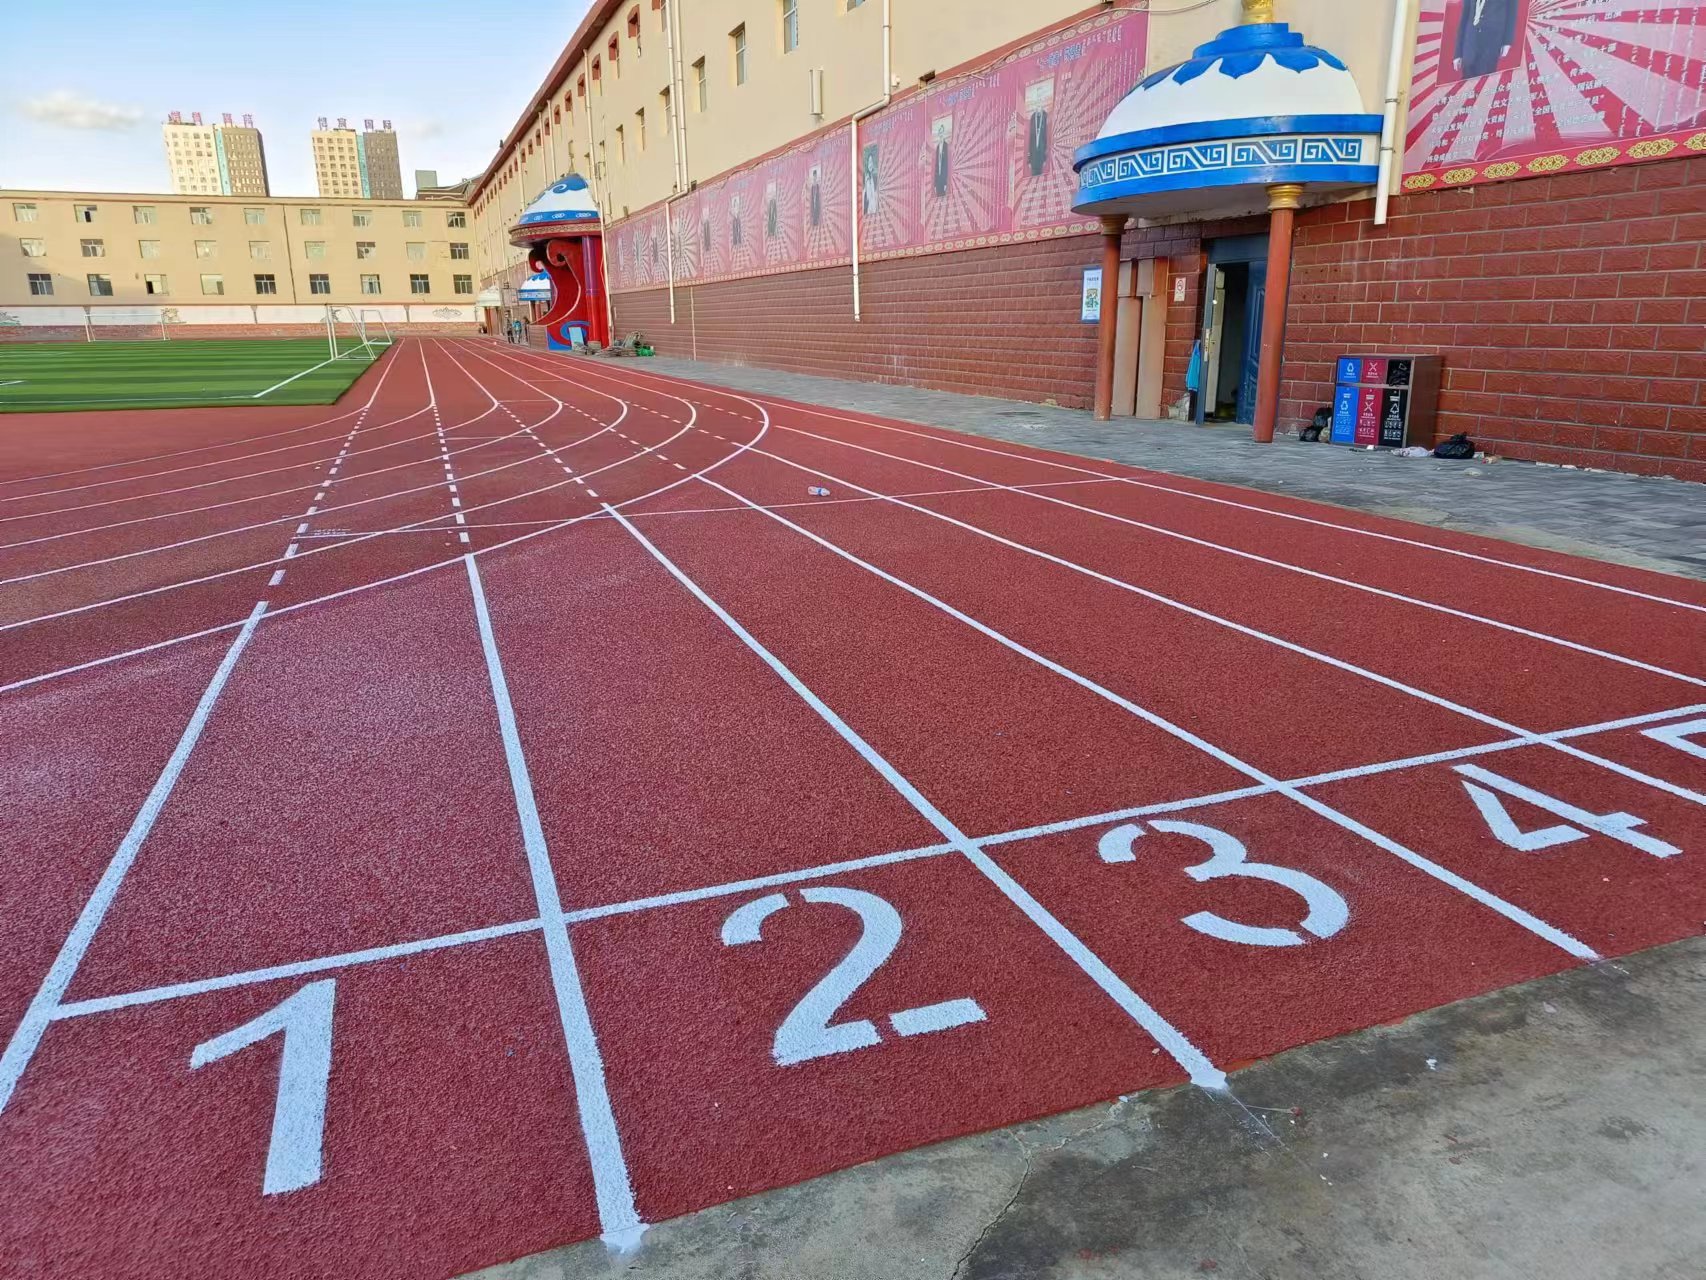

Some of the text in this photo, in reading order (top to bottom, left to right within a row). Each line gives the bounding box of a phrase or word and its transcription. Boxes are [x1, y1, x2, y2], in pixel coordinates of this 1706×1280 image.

[1098, 820, 1349, 946] 3
[1451, 763, 1684, 858] 4
[721, 885, 988, 1067] 2
[190, 978, 336, 1196] 1
